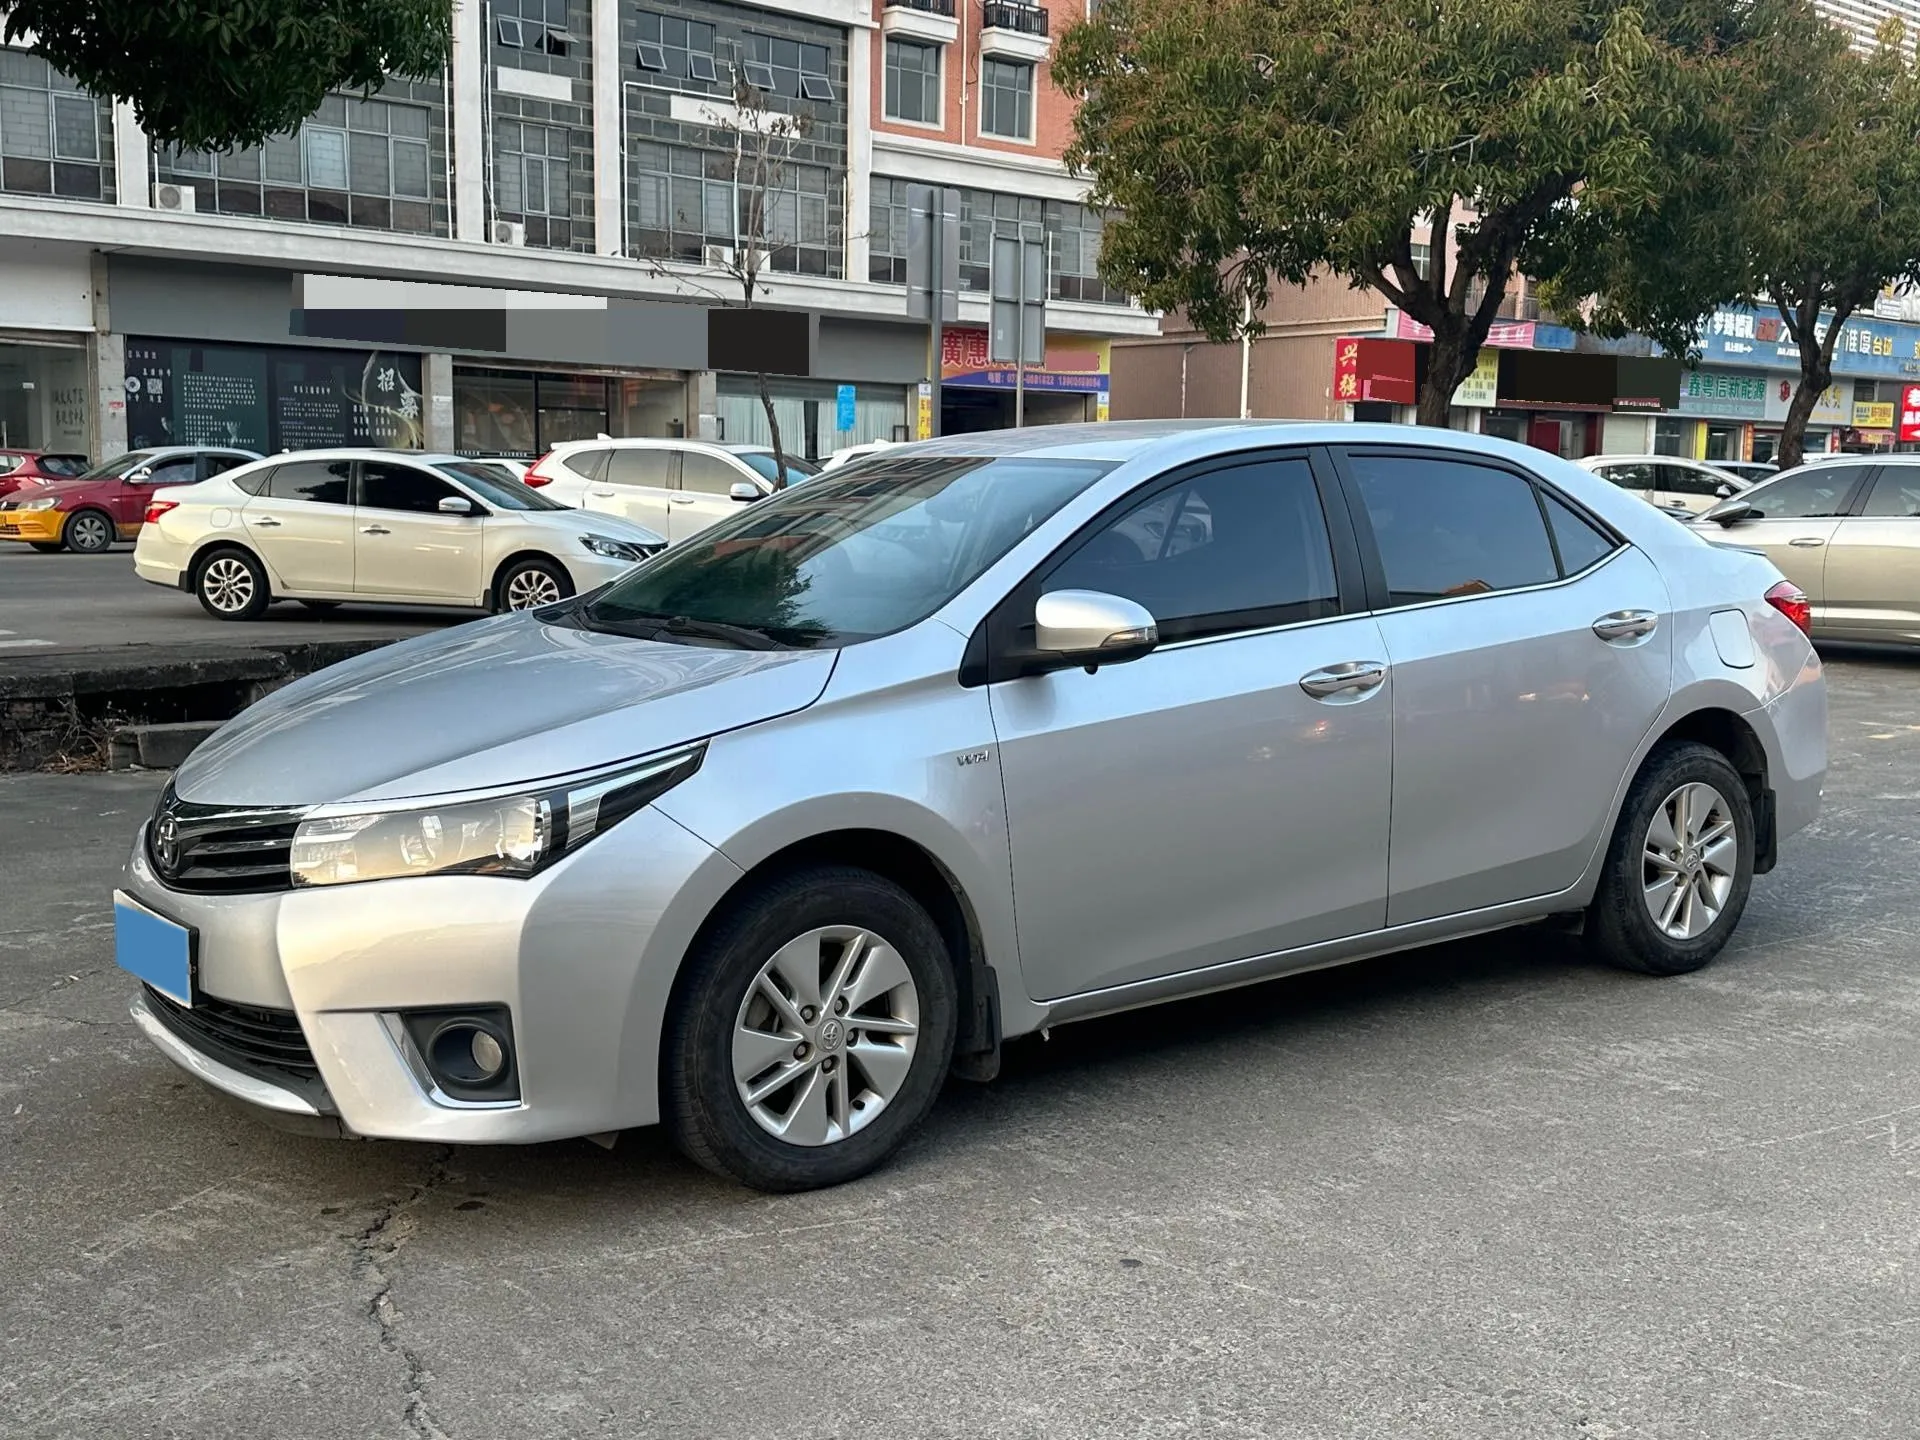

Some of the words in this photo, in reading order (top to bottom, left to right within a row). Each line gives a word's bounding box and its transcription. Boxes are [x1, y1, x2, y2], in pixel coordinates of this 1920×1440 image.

[1688, 371, 1767, 401] 鑫粤信新能源
